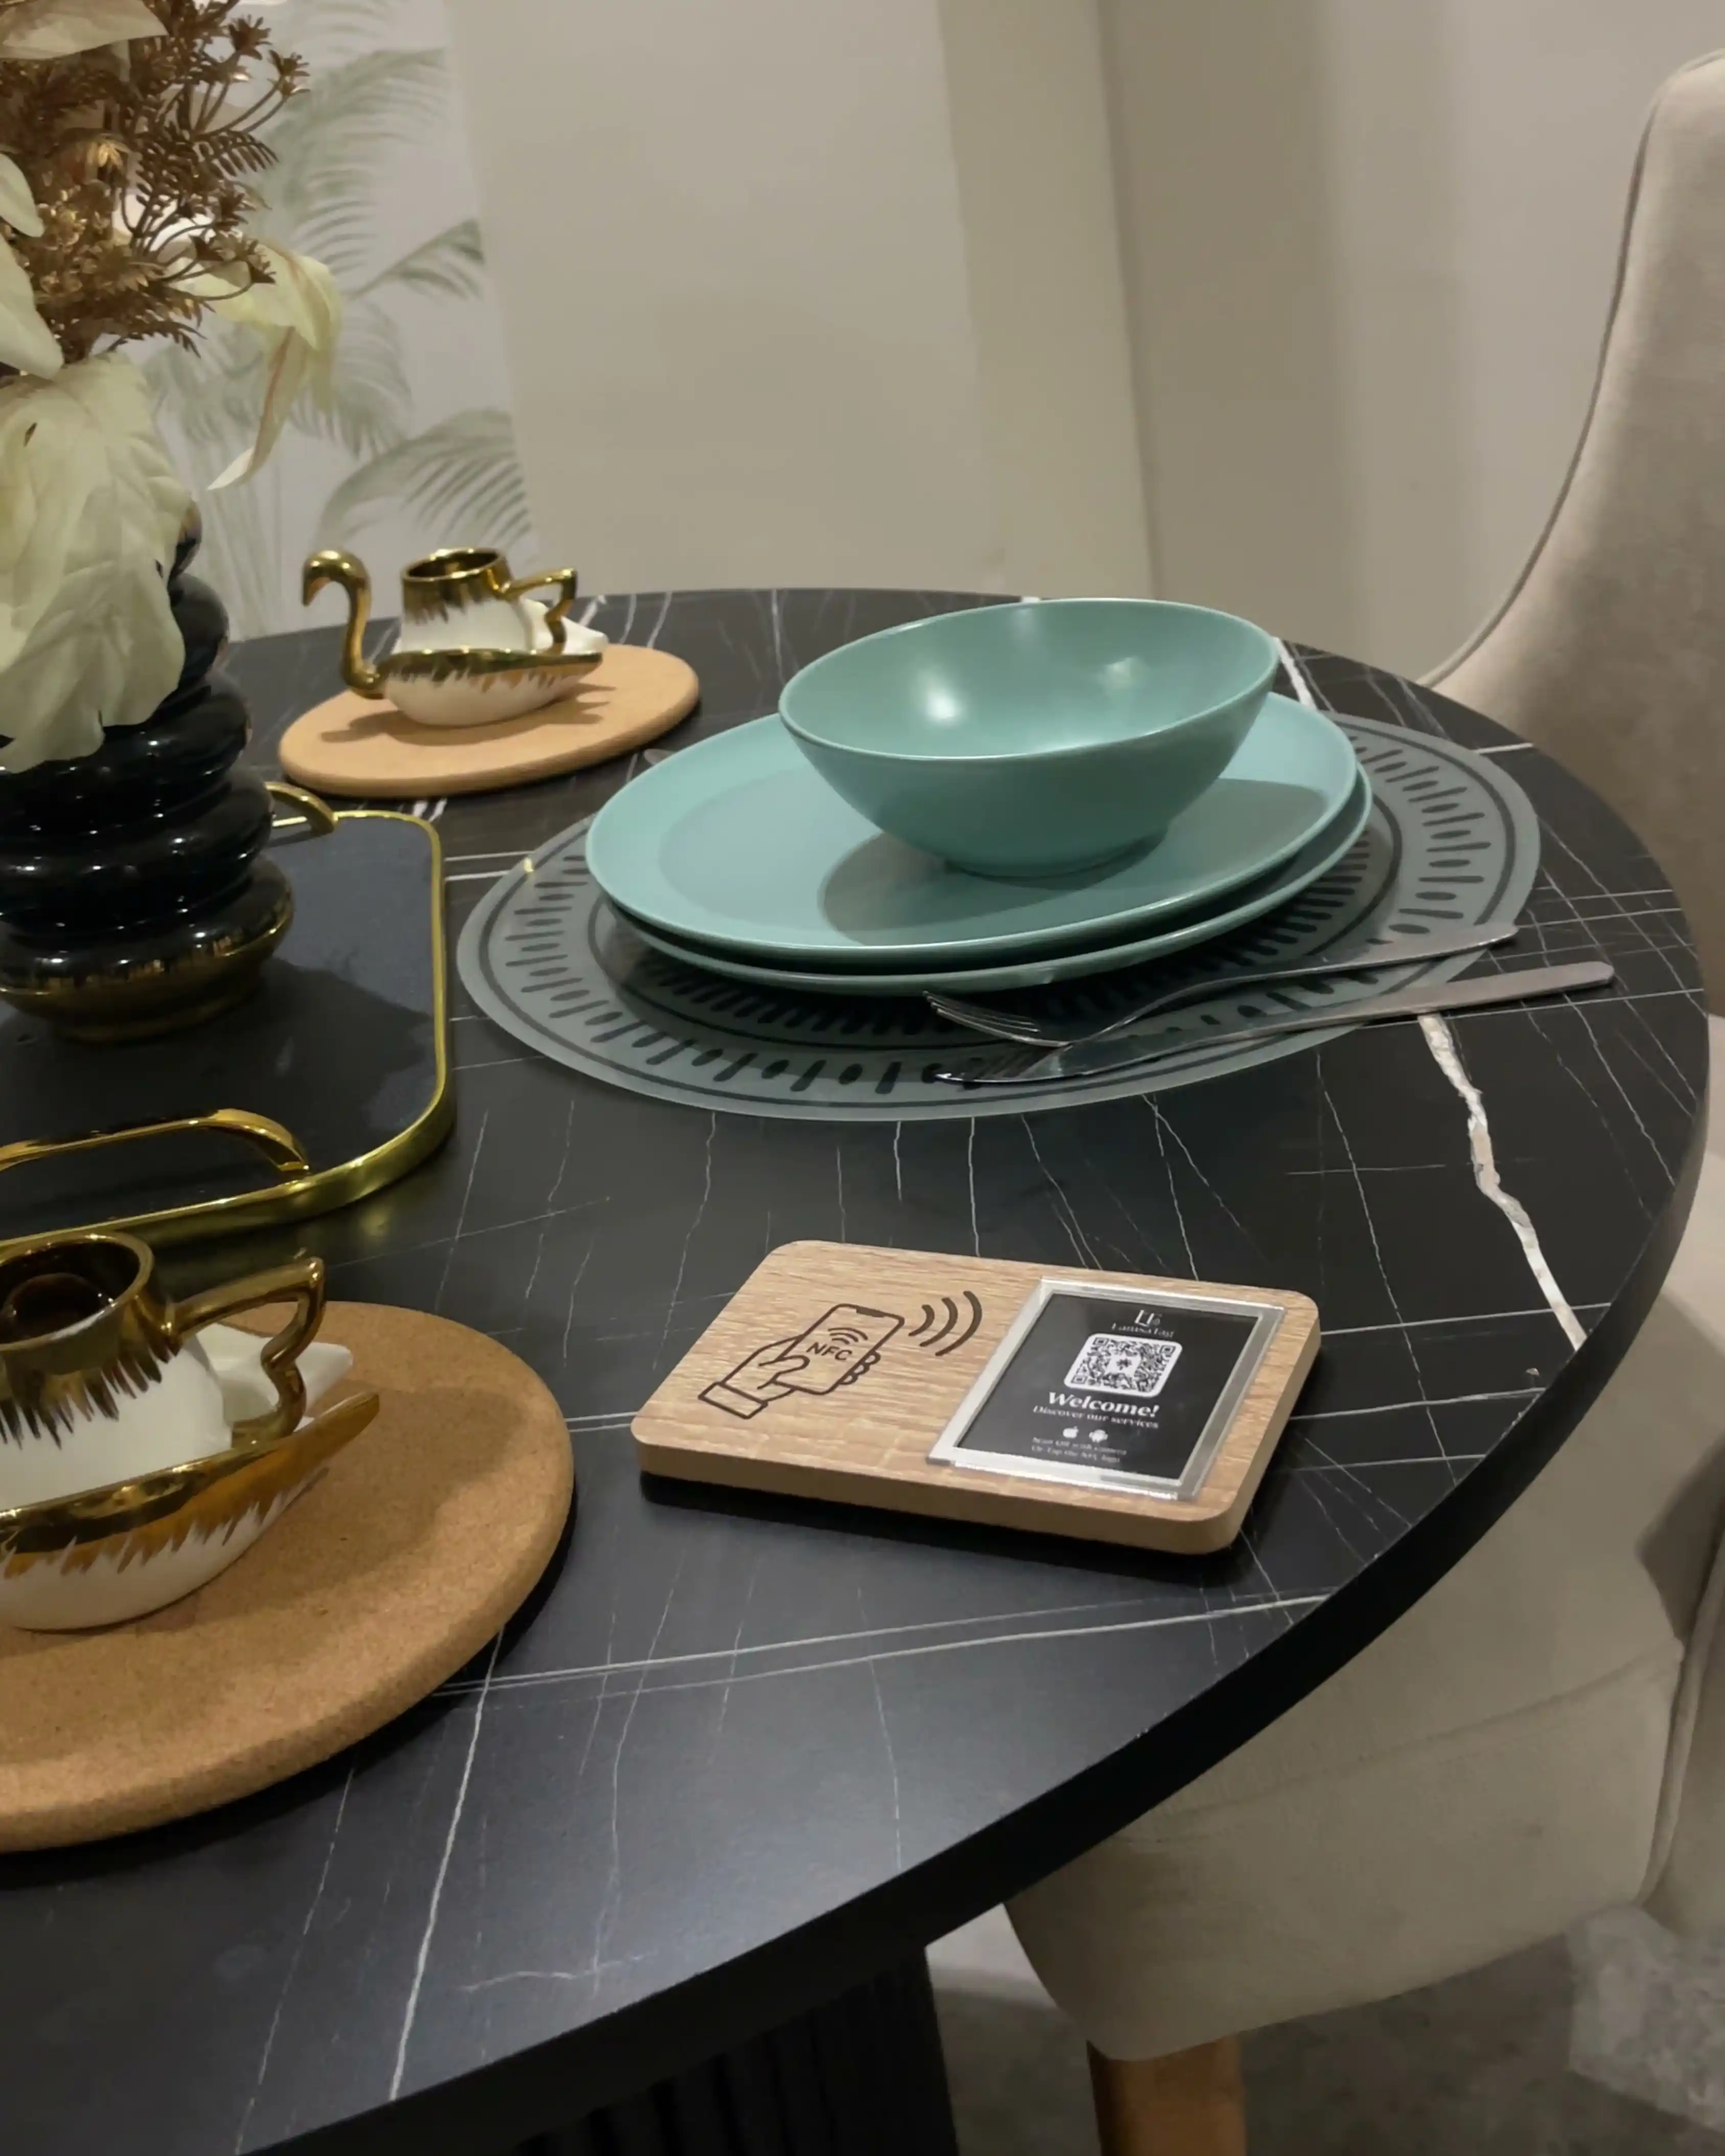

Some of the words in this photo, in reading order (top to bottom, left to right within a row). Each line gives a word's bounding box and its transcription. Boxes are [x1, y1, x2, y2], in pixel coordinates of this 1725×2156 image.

[806, 1341, 853, 1361] NFC
[1032, 1405, 1086, 1419] Discover
[1087, 1413, 1109, 1422] our
[1111, 1416, 1159, 1429] services
[1049, 1392, 1160, 1418] Welcome!
